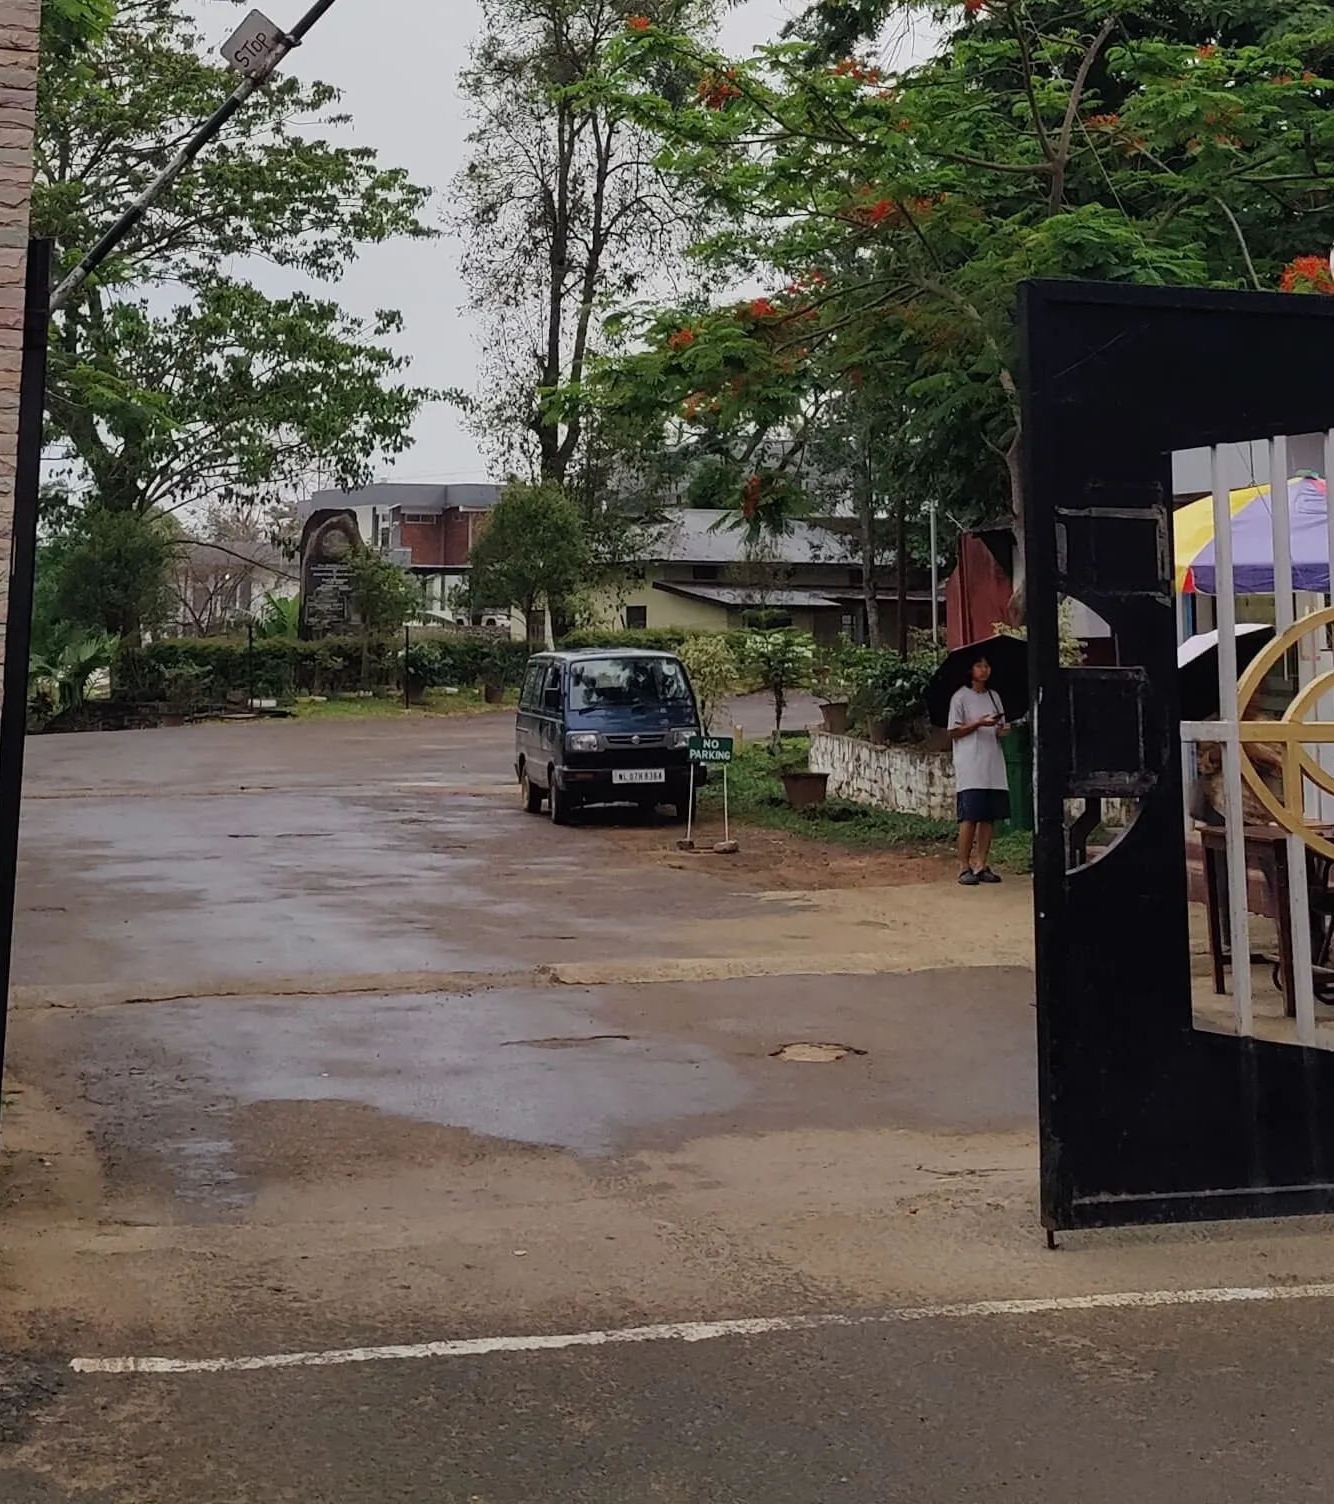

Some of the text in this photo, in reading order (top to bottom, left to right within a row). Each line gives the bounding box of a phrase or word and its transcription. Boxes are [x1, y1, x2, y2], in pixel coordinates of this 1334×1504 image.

[234, 32, 269, 67] STOP
[703, 739, 719, 749] NO
[689, 749, 731, 760] PARKING
